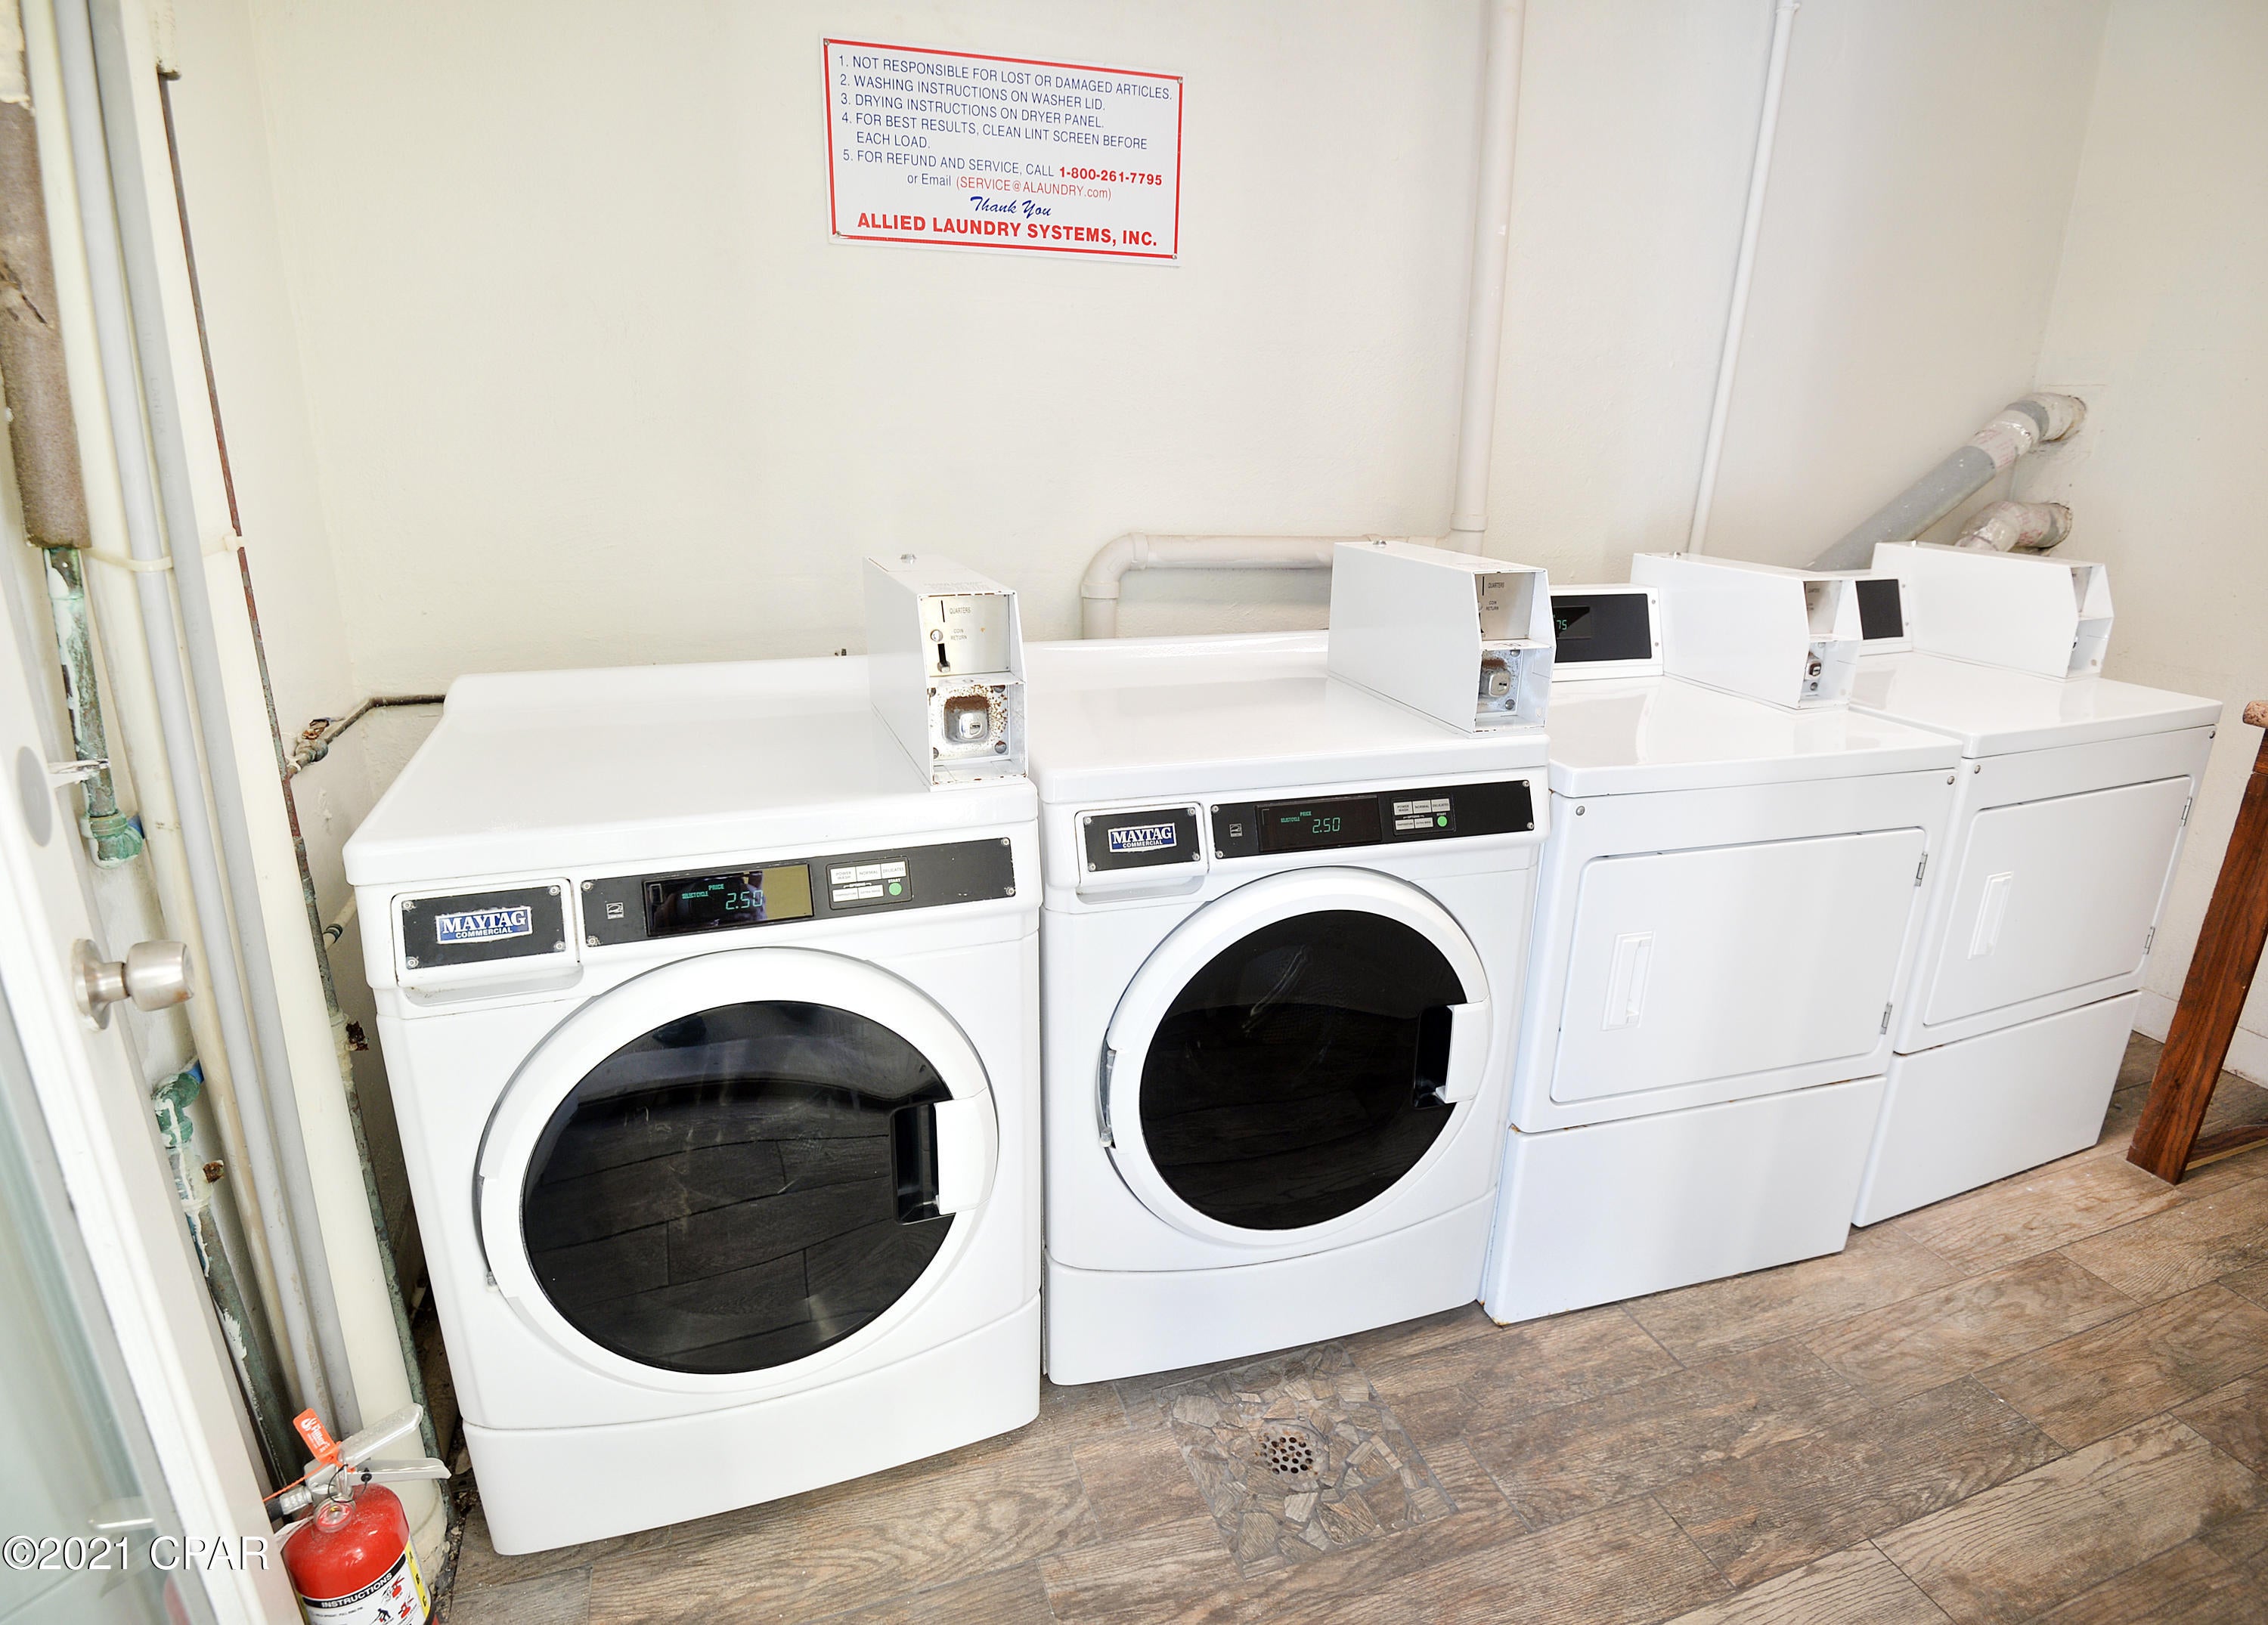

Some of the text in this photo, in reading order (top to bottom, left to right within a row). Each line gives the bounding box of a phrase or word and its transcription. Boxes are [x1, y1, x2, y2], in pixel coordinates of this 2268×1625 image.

[838, 54, 1172, 101] 1. NOT RESPONSIBLE FOR LOST OR DAMAGED ARTICLES.
[840, 73, 1105, 111] 2. WASHING INSTRUCTIONS ON WASHER LID.
[841, 92, 1105, 128] 3. DRYING INSTRUCTIONS ON DRYER PANEL.
[841, 111, 1148, 150] 4. FOR BEST RESULTS, CLEAN LINT SCREEN BEFORE
[857, 131, 931, 149] EACH LOAD.
[843, 148, 1163, 186] 5. FOR REFUND AND SERVICE, CALL 1-800-261-7795
[907, 175, 919, 184] or
[922, 172, 951, 187] Email
[969, 196, 1052, 219] Thank You
[857, 212, 1157, 247] ALLIED LAUNDRY SYSTEMS, INC.
[1111, 827, 1172, 844] MAYTAG
[1312, 817, 1341, 834] 2.50
[1122, 840, 1163, 849] COMMERCIAL
[726, 890, 764, 910] 2.50
[441, 911, 526, 934] MAYTAG
[456, 927, 513, 939] COMMERCIAL
[321, 1573, 392, 1608] INSTRUCTIONS
